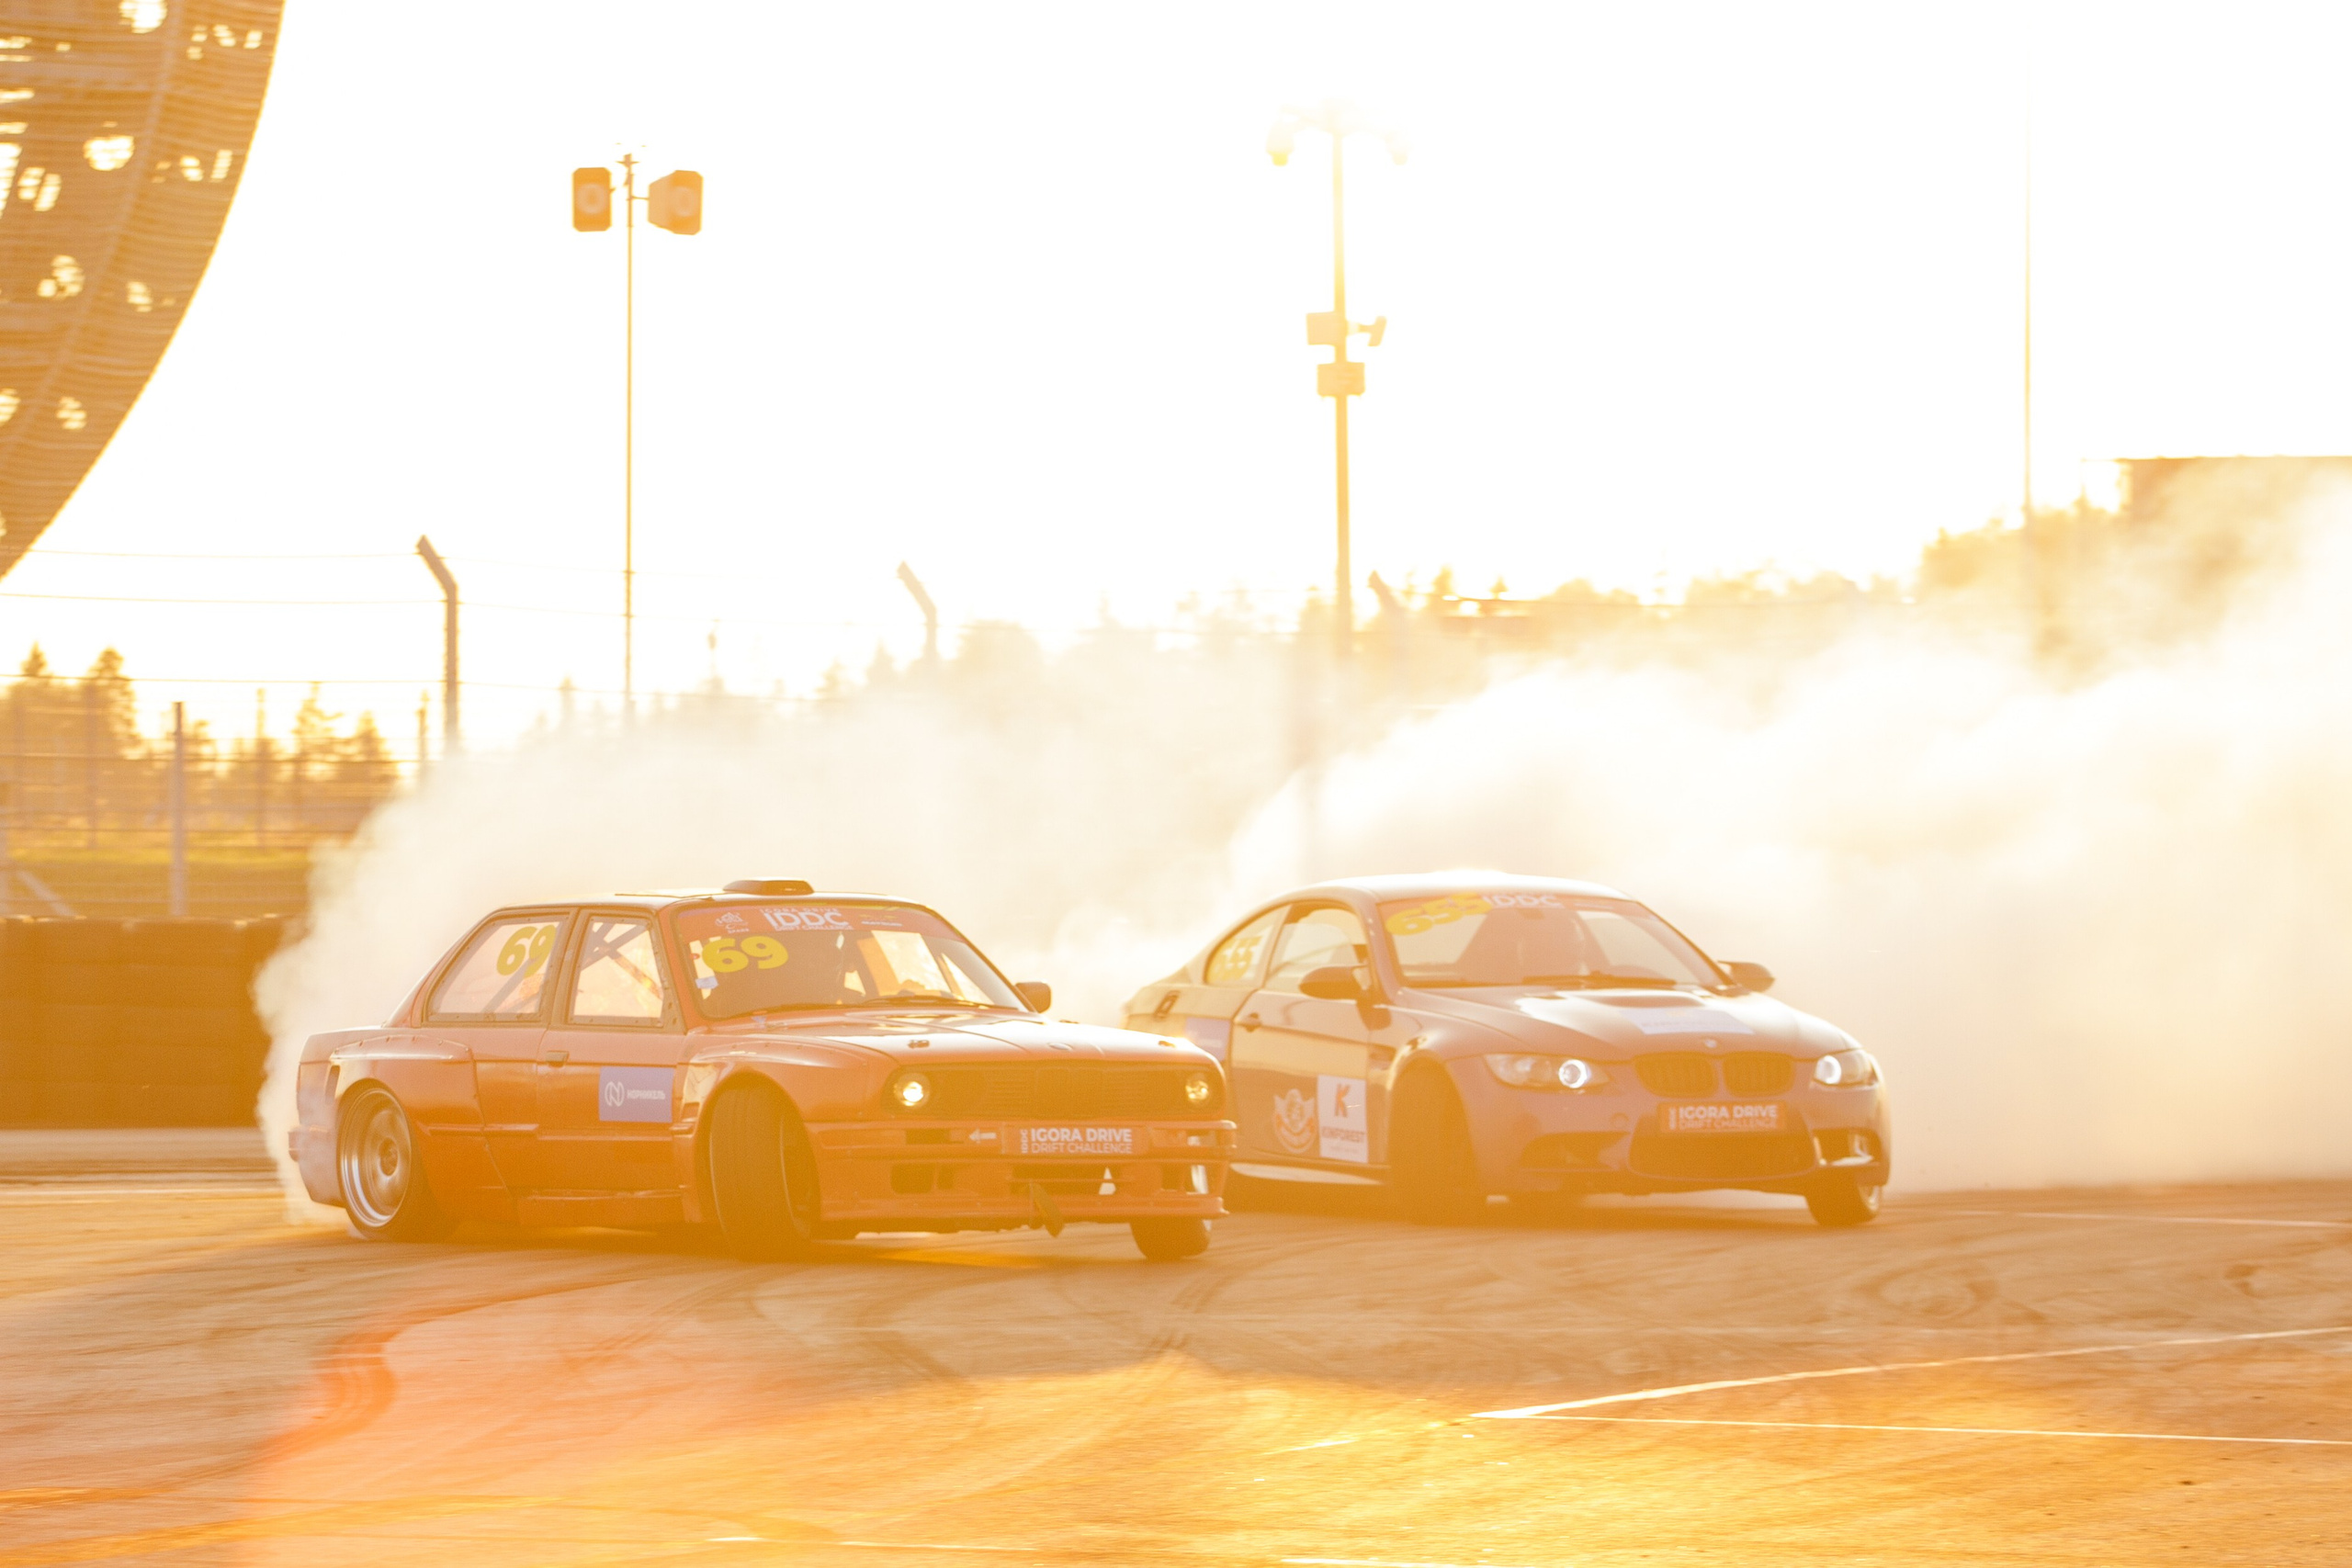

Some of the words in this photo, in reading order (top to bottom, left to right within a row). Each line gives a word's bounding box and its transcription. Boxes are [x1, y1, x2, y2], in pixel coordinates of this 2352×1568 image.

[763, 911, 850, 928] IDDC
[1385, 892, 1492, 936] 655
[496, 924, 557, 977] 69
[702, 936, 788, 973] 69
[1334, 1084, 1351, 1118] K
[1679, 1105, 1729, 1120] IGORA
[1733, 1104, 1778, 1118] DRIVE
[1031, 1128, 1082, 1142] IGORA
[1086, 1128, 1133, 1142] DRIVE
[1031, 1143, 1065, 1154] DRIFT
[1068, 1142, 1133, 1154] CHALLENGE
